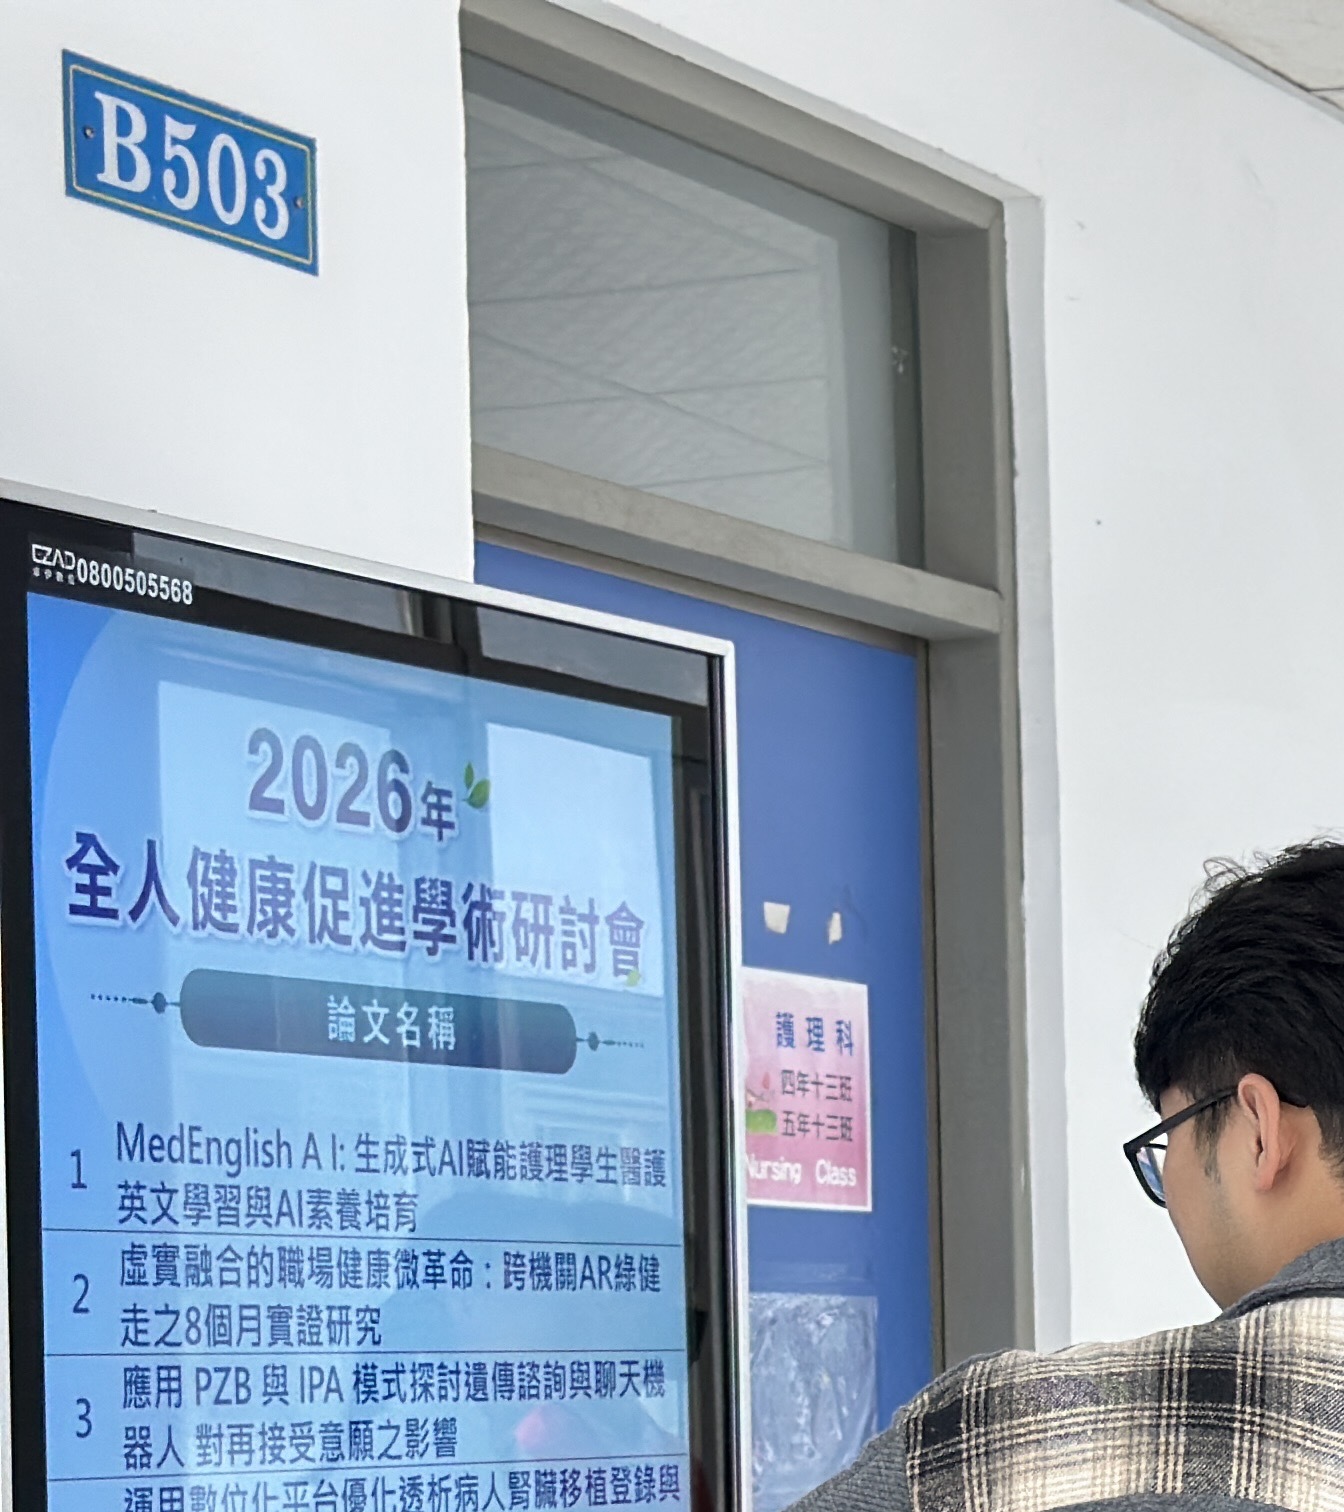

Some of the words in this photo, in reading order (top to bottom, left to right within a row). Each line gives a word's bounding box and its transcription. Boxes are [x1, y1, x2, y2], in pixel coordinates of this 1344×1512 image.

[95, 91, 290, 240] B503
[77, 558, 193, 605] 0800505568
[246, 728, 457, 842] 2026年
[65, 831, 645, 978] 全人健康促進學術研討會
[327, 994, 457, 1051] 論文名稱
[70, 1149, 88, 1189] 1
[116, 1121, 292, 1178] MedEnglish
[302, 1131, 323, 1170] A
[355, 1132, 667, 1188] 生成式AI賦能護理學生醫護
[815, 1158, 857, 1187] Class
[117, 1179, 419, 1233] 英文學習與AI素養培育
[72, 1273, 90, 1314] 2
[120, 1303, 382, 1348] 走之8個月實證研究
[75, 1397, 92, 1439] 3
[123, 1364, 182, 1409] 應用
[195, 1366, 251, 1406] PZB
[262, 1363, 289, 1407] 與
[300, 1365, 344, 1403] IPA
[352, 1359, 665, 1404] 模式探討遺傳諮詢與聊天機
[124, 1424, 185, 1470] 器人
[196, 1416, 457, 1467] 對再接受意願之影響
